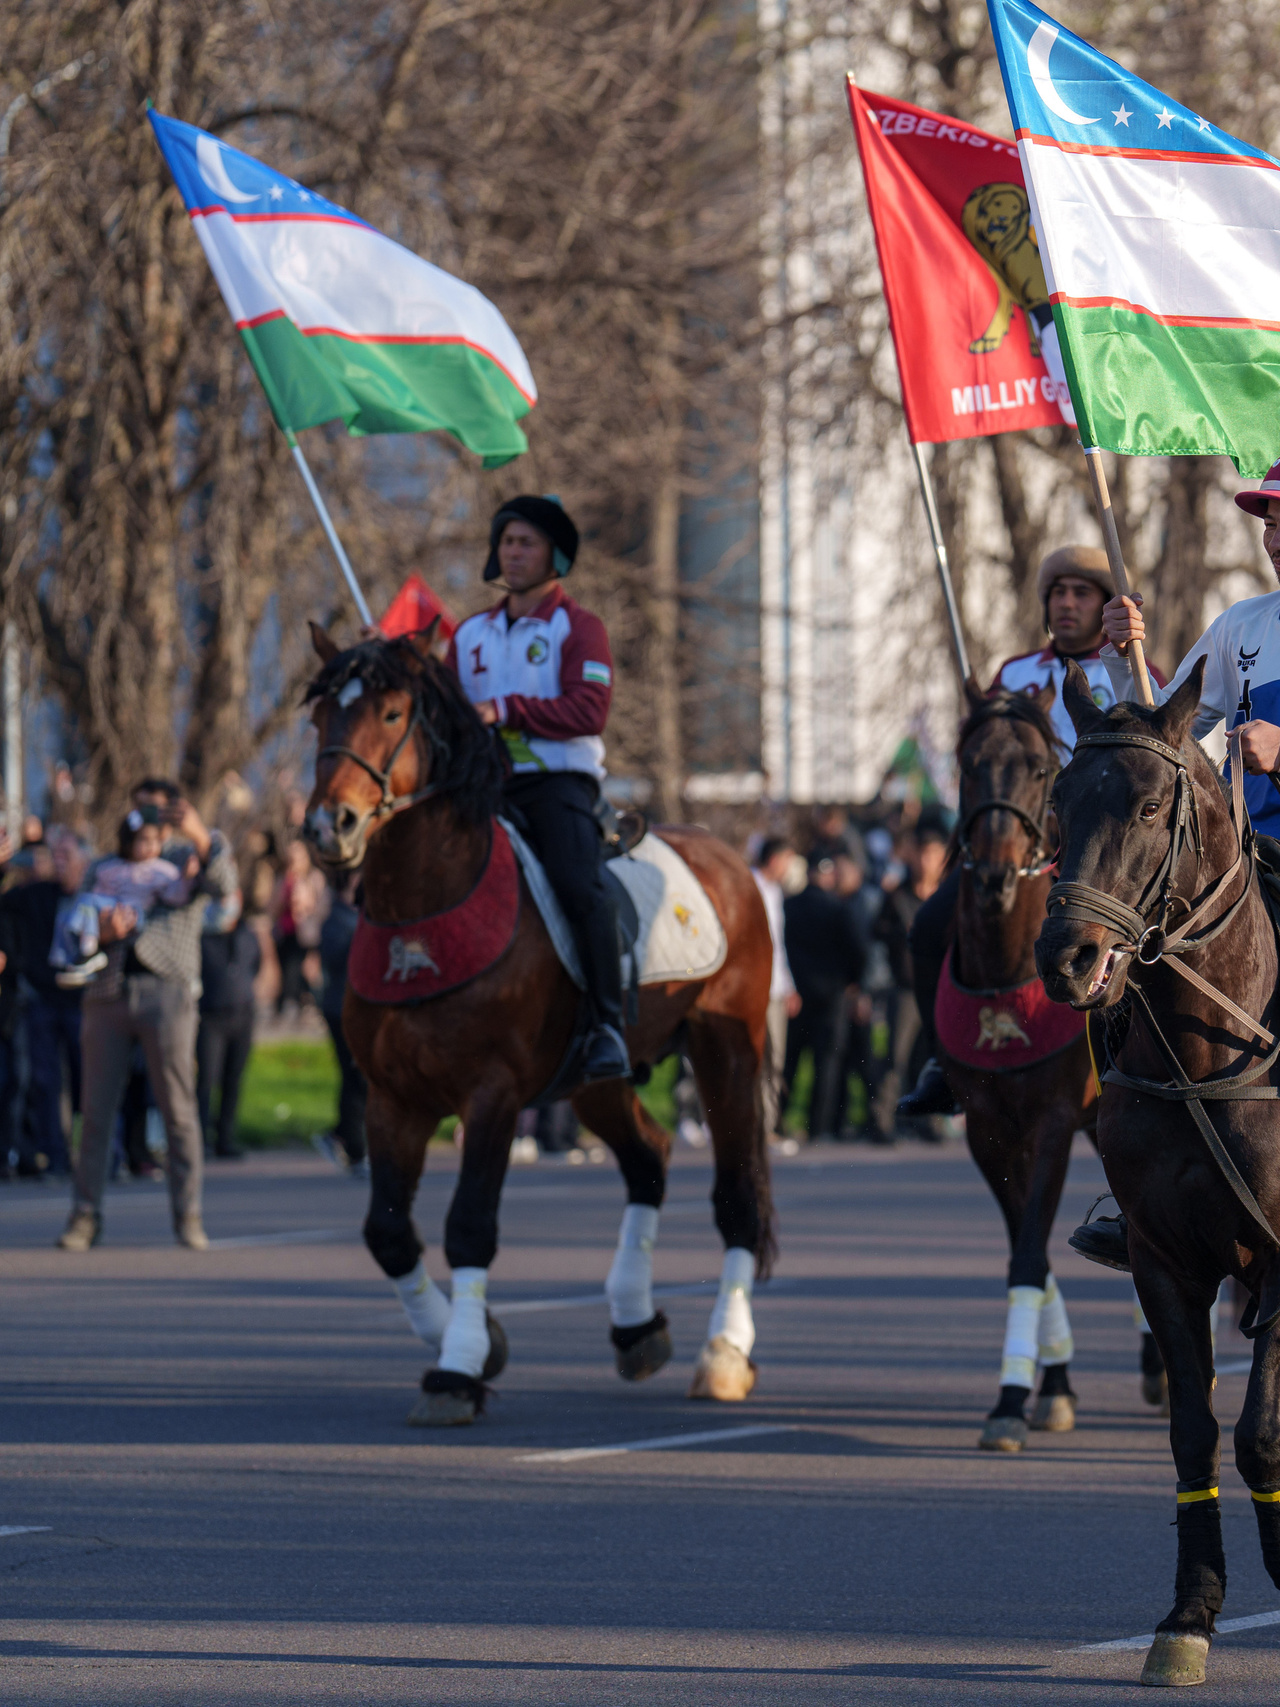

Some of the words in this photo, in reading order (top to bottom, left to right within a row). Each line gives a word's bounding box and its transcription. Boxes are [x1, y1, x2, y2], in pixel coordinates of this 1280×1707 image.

[951, 377, 1037, 416] MILLIY
[471, 643, 488, 676] 1
[1236, 679, 1252, 723] 4
